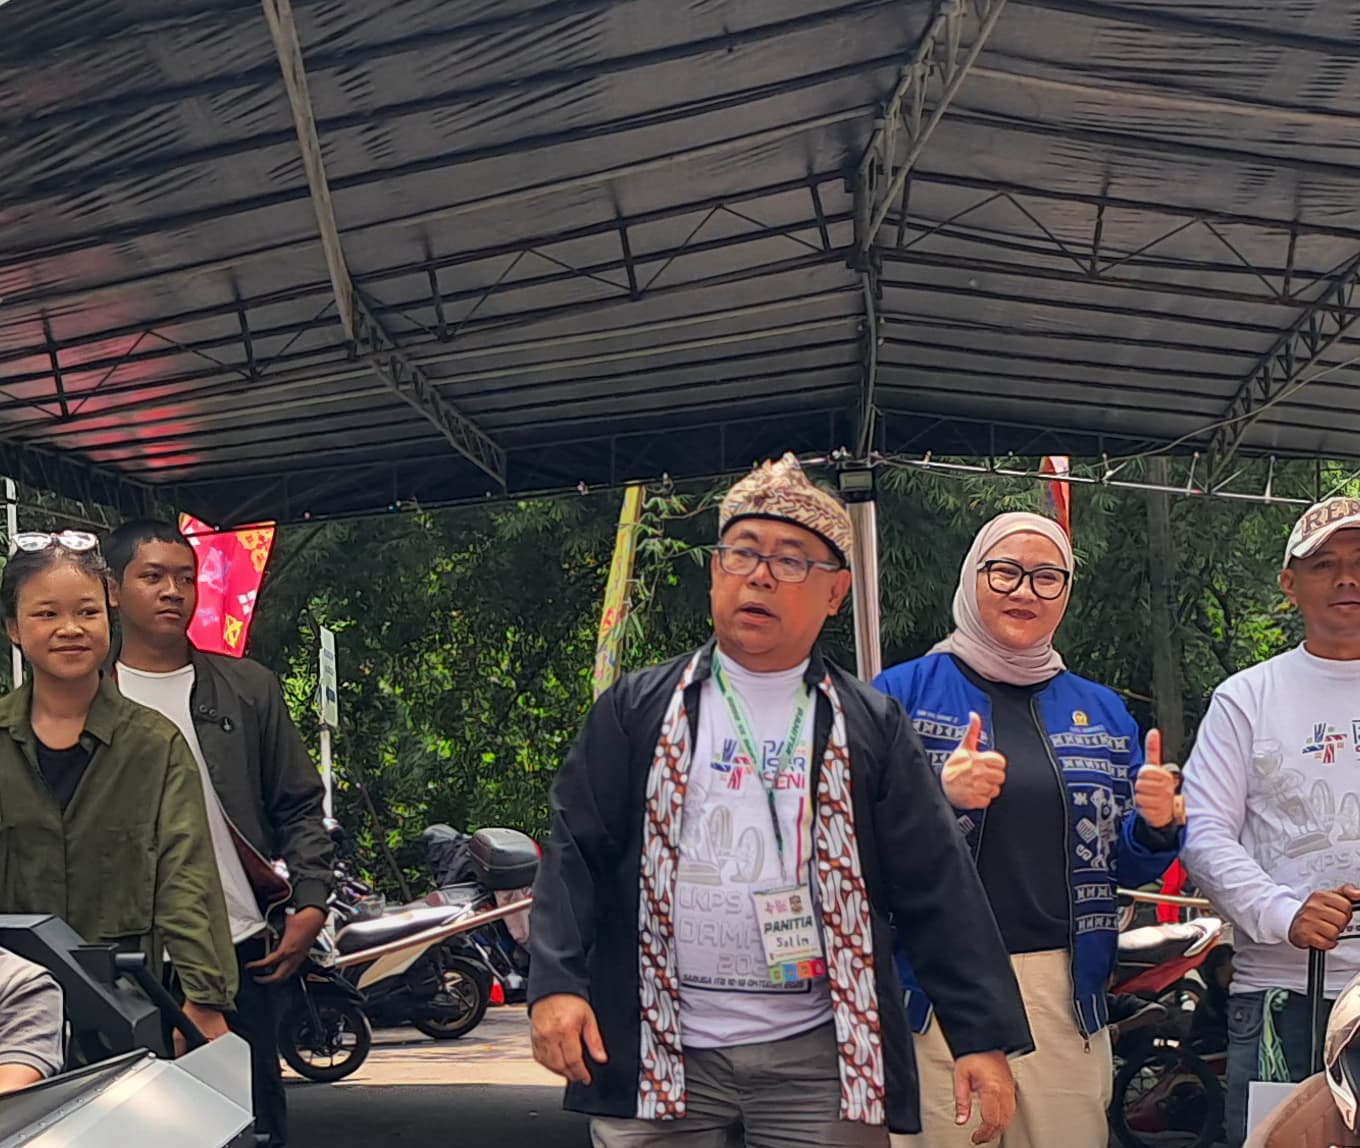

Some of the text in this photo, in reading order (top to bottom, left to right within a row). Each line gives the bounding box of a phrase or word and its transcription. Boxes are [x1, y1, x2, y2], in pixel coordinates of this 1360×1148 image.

[679, 918, 761, 949] DAMA
[764, 915, 813, 935] PANITIA
[717, 952, 769, 979] 202
